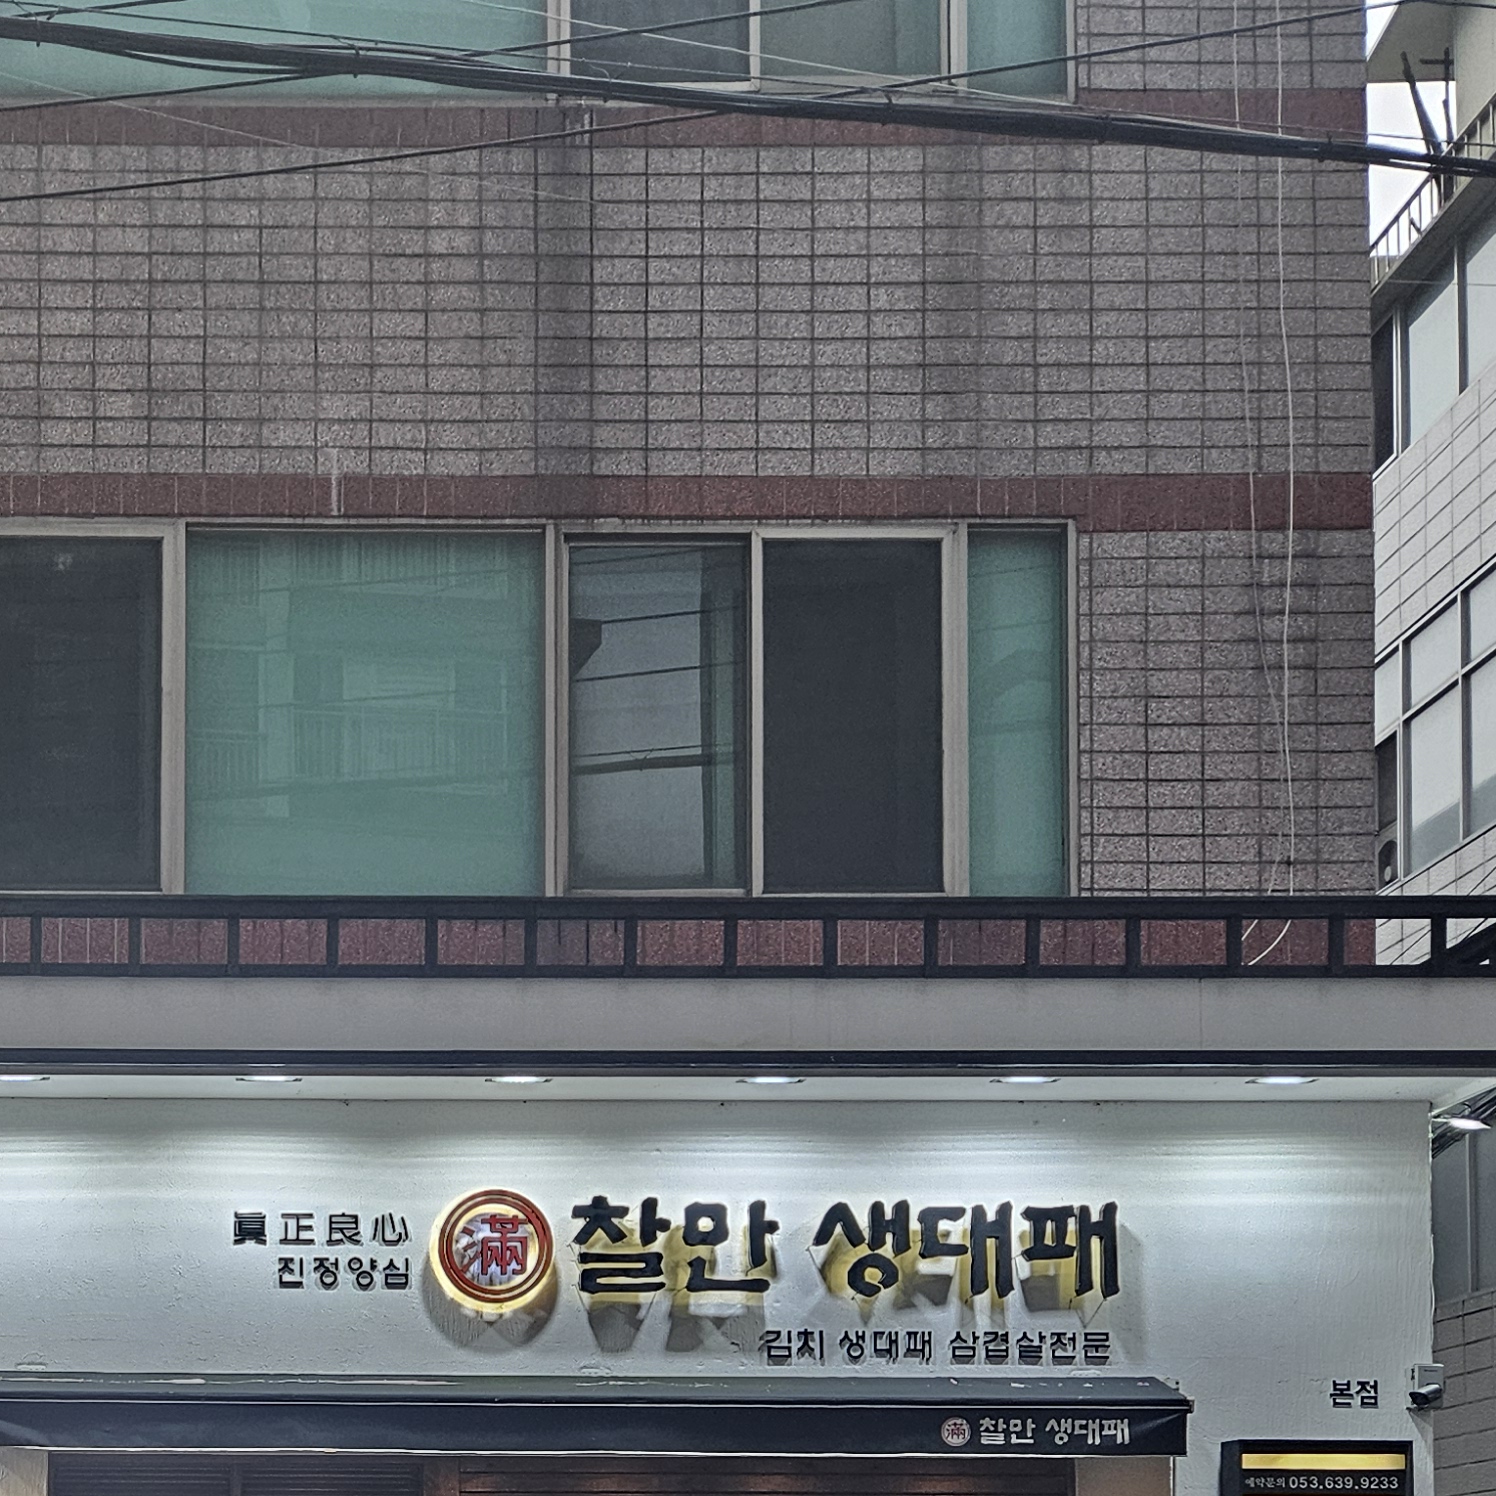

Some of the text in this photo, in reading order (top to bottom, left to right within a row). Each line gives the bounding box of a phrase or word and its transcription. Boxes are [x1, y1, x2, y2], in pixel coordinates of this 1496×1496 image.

[571, 1195, 1119, 1298] 찰만 생대패
[277, 1256, 409, 1290] 진정양심
[765, 1329, 1112, 1365] 김치 생대패 삼겹살전문
[1329, 1379, 1379, 1409] 본점
[979, 1417, 1131, 1445] 찰만 생대패
[1245, 1476, 1399, 1490] 예약문의 053.639.9233
